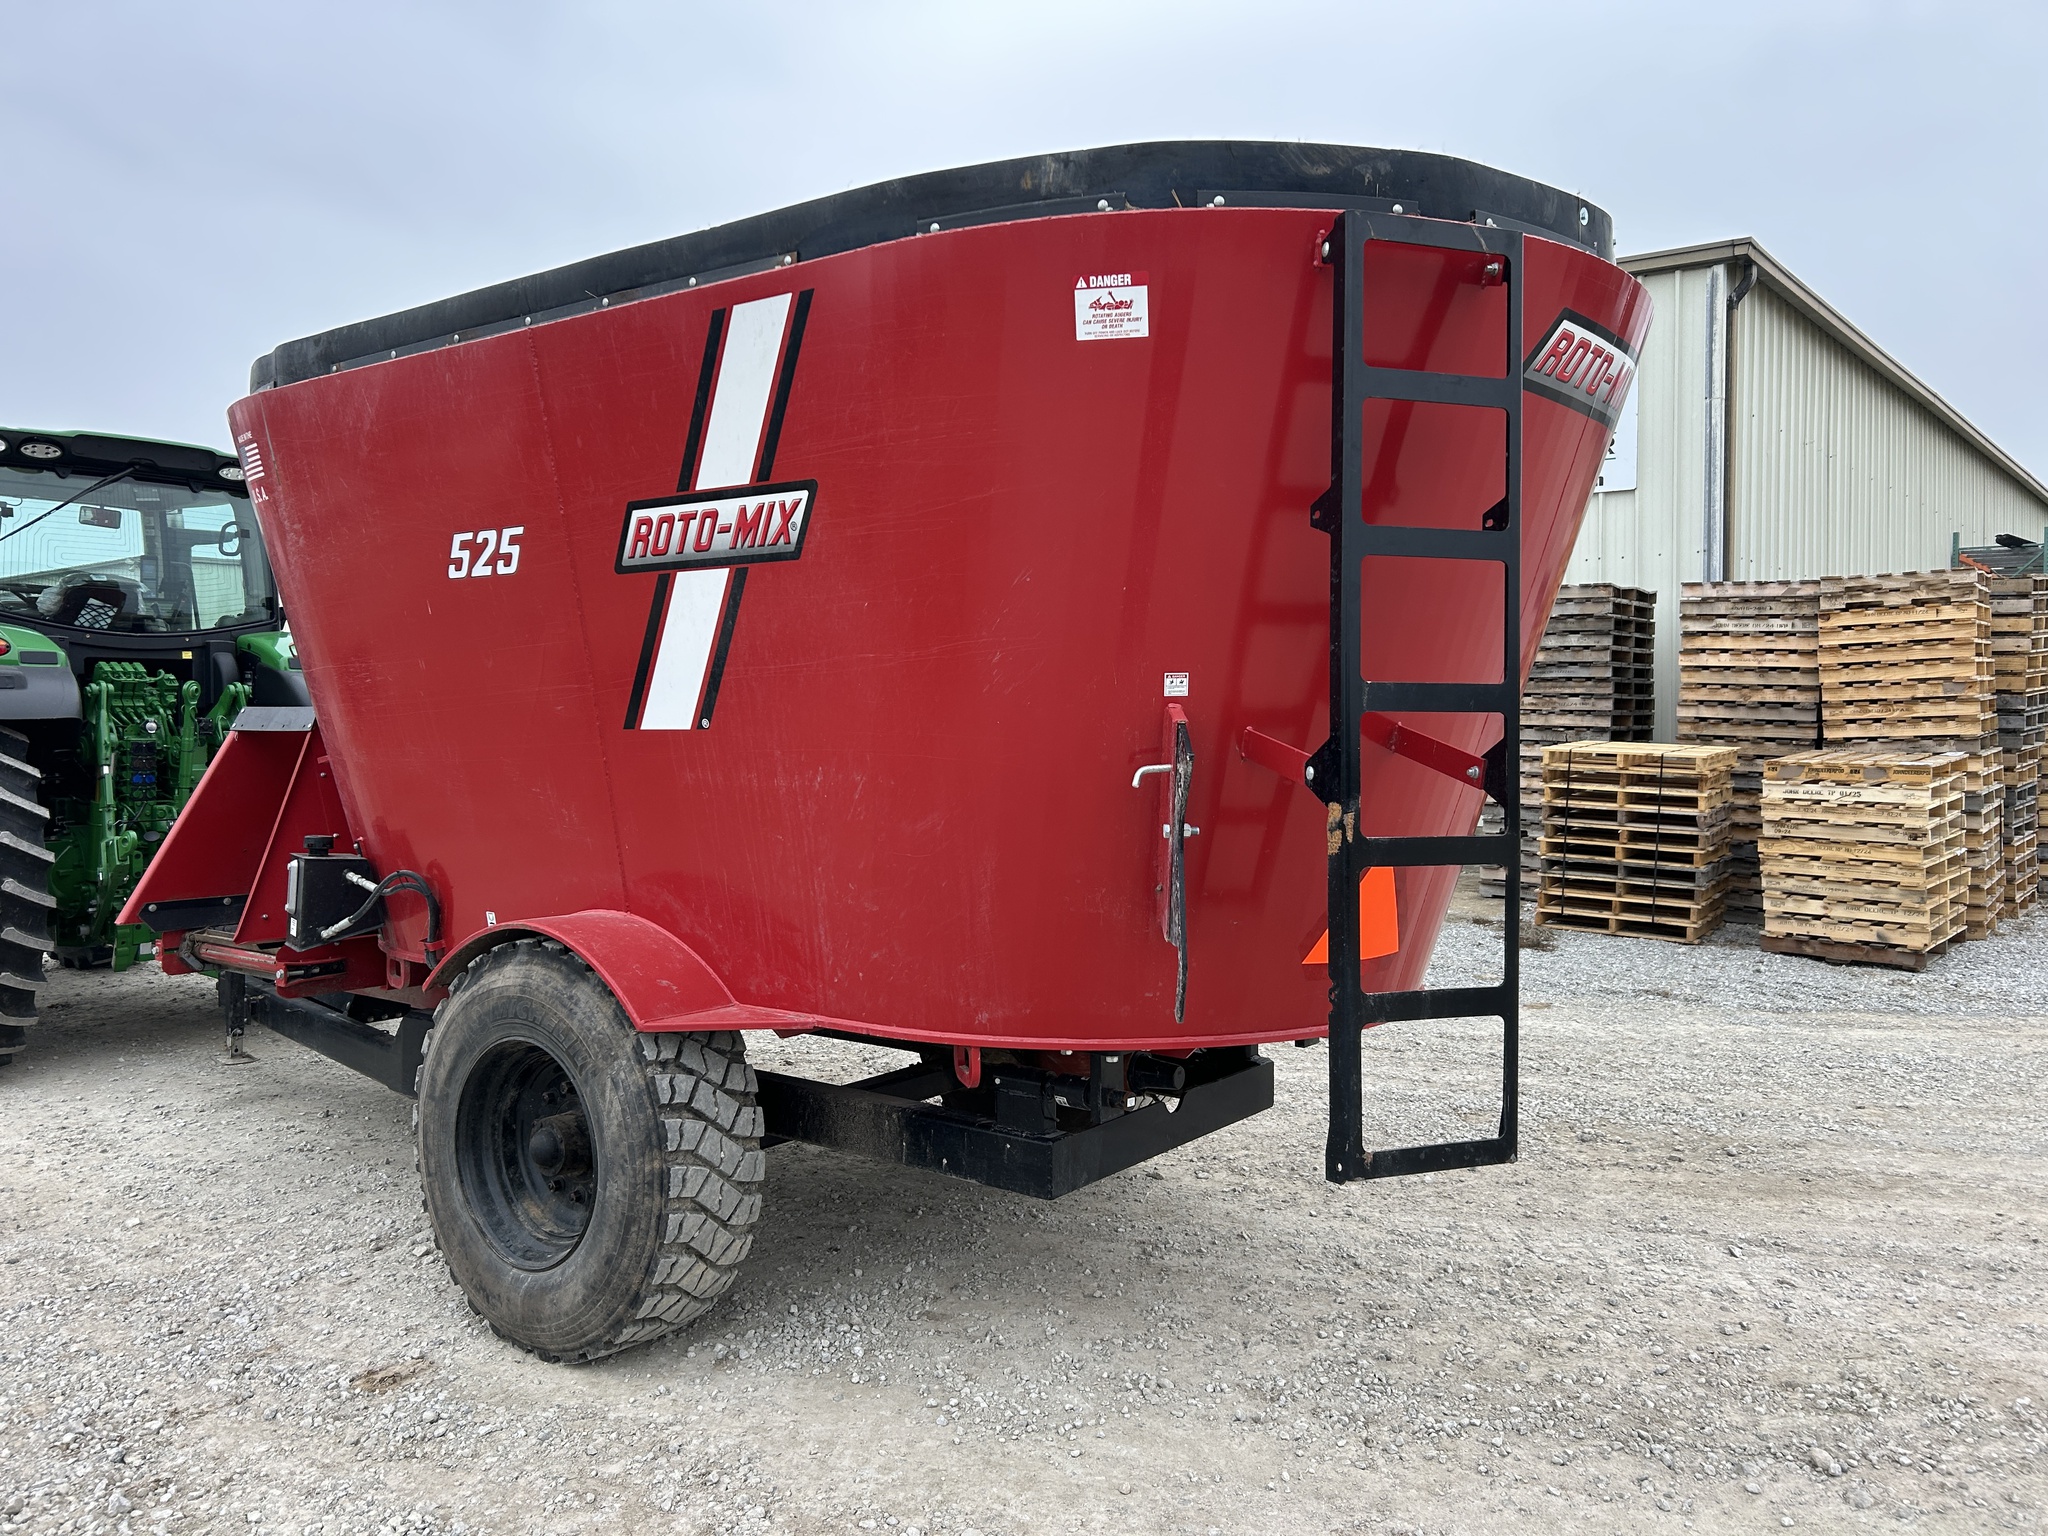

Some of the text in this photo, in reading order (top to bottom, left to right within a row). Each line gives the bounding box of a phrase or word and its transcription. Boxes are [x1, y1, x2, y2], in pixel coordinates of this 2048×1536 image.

[1089, 274, 1132, 287] DANGER
[447, 525, 526, 579] 525
[627, 498, 802, 559] ROTO-MIX
[491, 996, 592, 1078] MICHELIN
